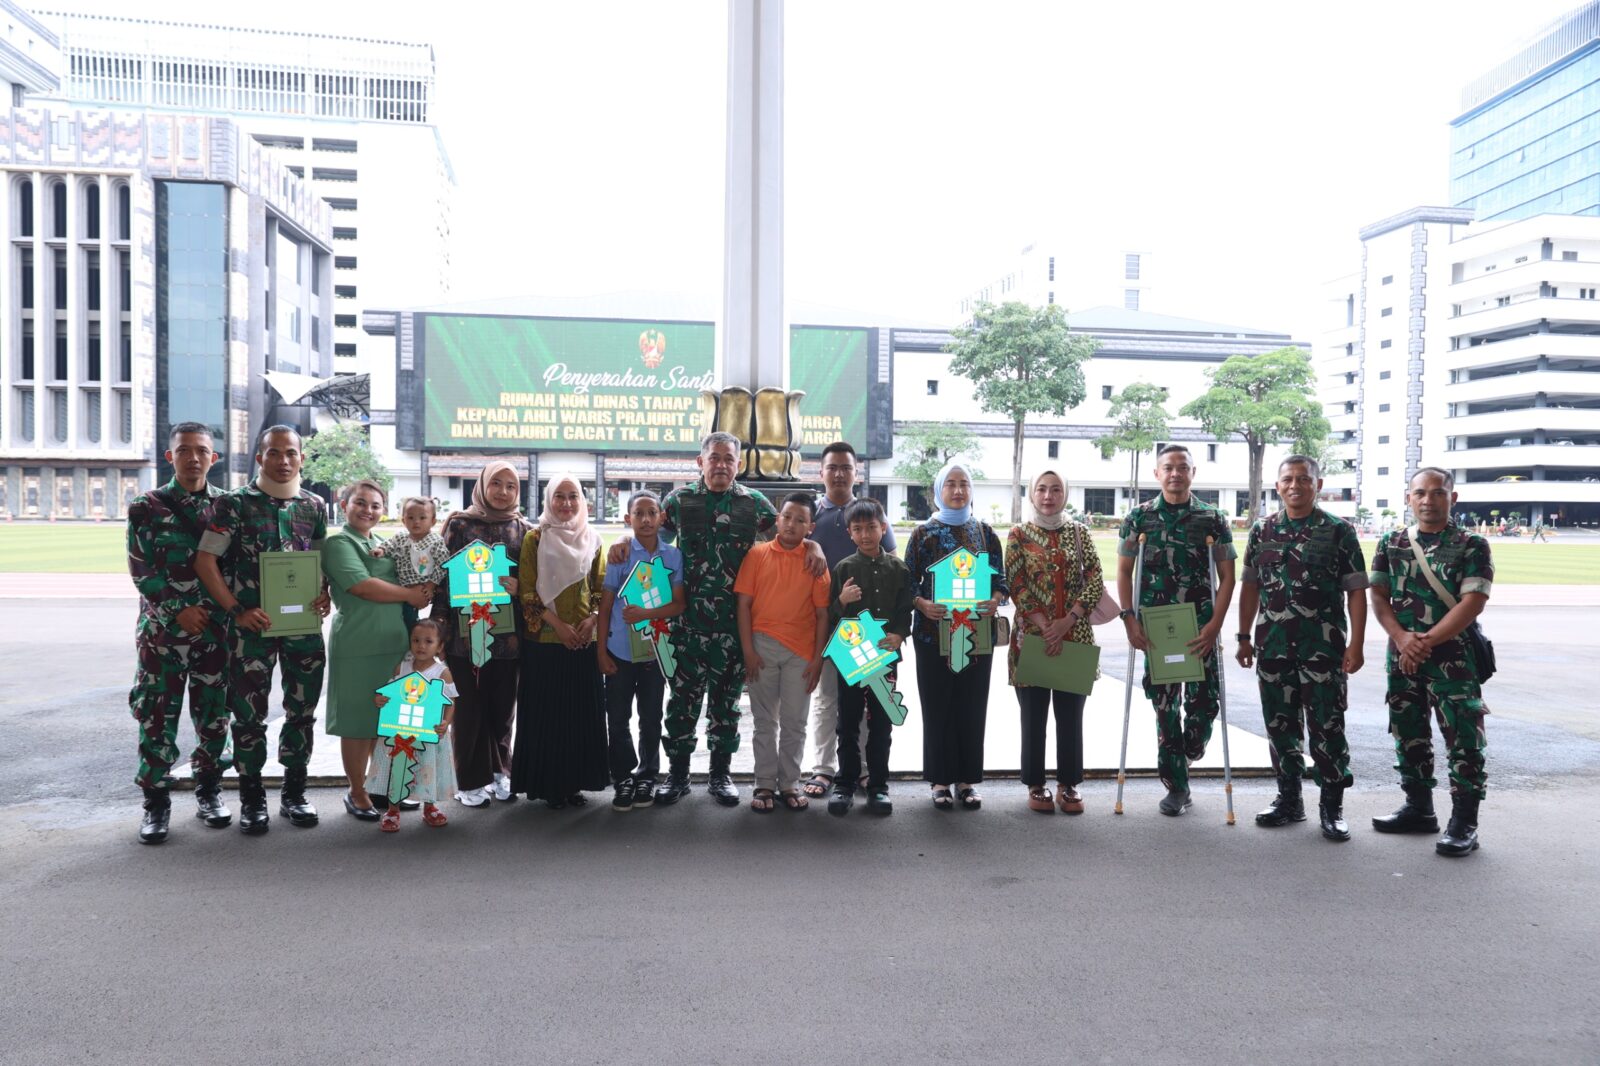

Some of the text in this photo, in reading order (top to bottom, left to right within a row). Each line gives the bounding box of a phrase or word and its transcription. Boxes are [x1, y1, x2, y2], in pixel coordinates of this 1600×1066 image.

[543, 363, 658, 394] Penyerahan
[500, 392, 555, 408] RUMAH
[559, 394, 589, 408] NON
[593, 394, 639, 409] DINAS
[643, 396, 693, 410] TAHAP
[457, 407, 518, 422] KEPADA
[523, 408, 556, 423] AHLI
[560, 410, 612, 424] WARIS
[616, 411, 685, 426] PRAJURIT
[451, 424, 483, 438] DAN
[487, 424, 559, 440] PRAJURIT
[563, 426, 615, 441] CACAT
[620, 427, 644, 441] TK.
[648, 428, 659, 441] II
[663, 428, 676, 442] &
[680, 428, 694, 442] III
